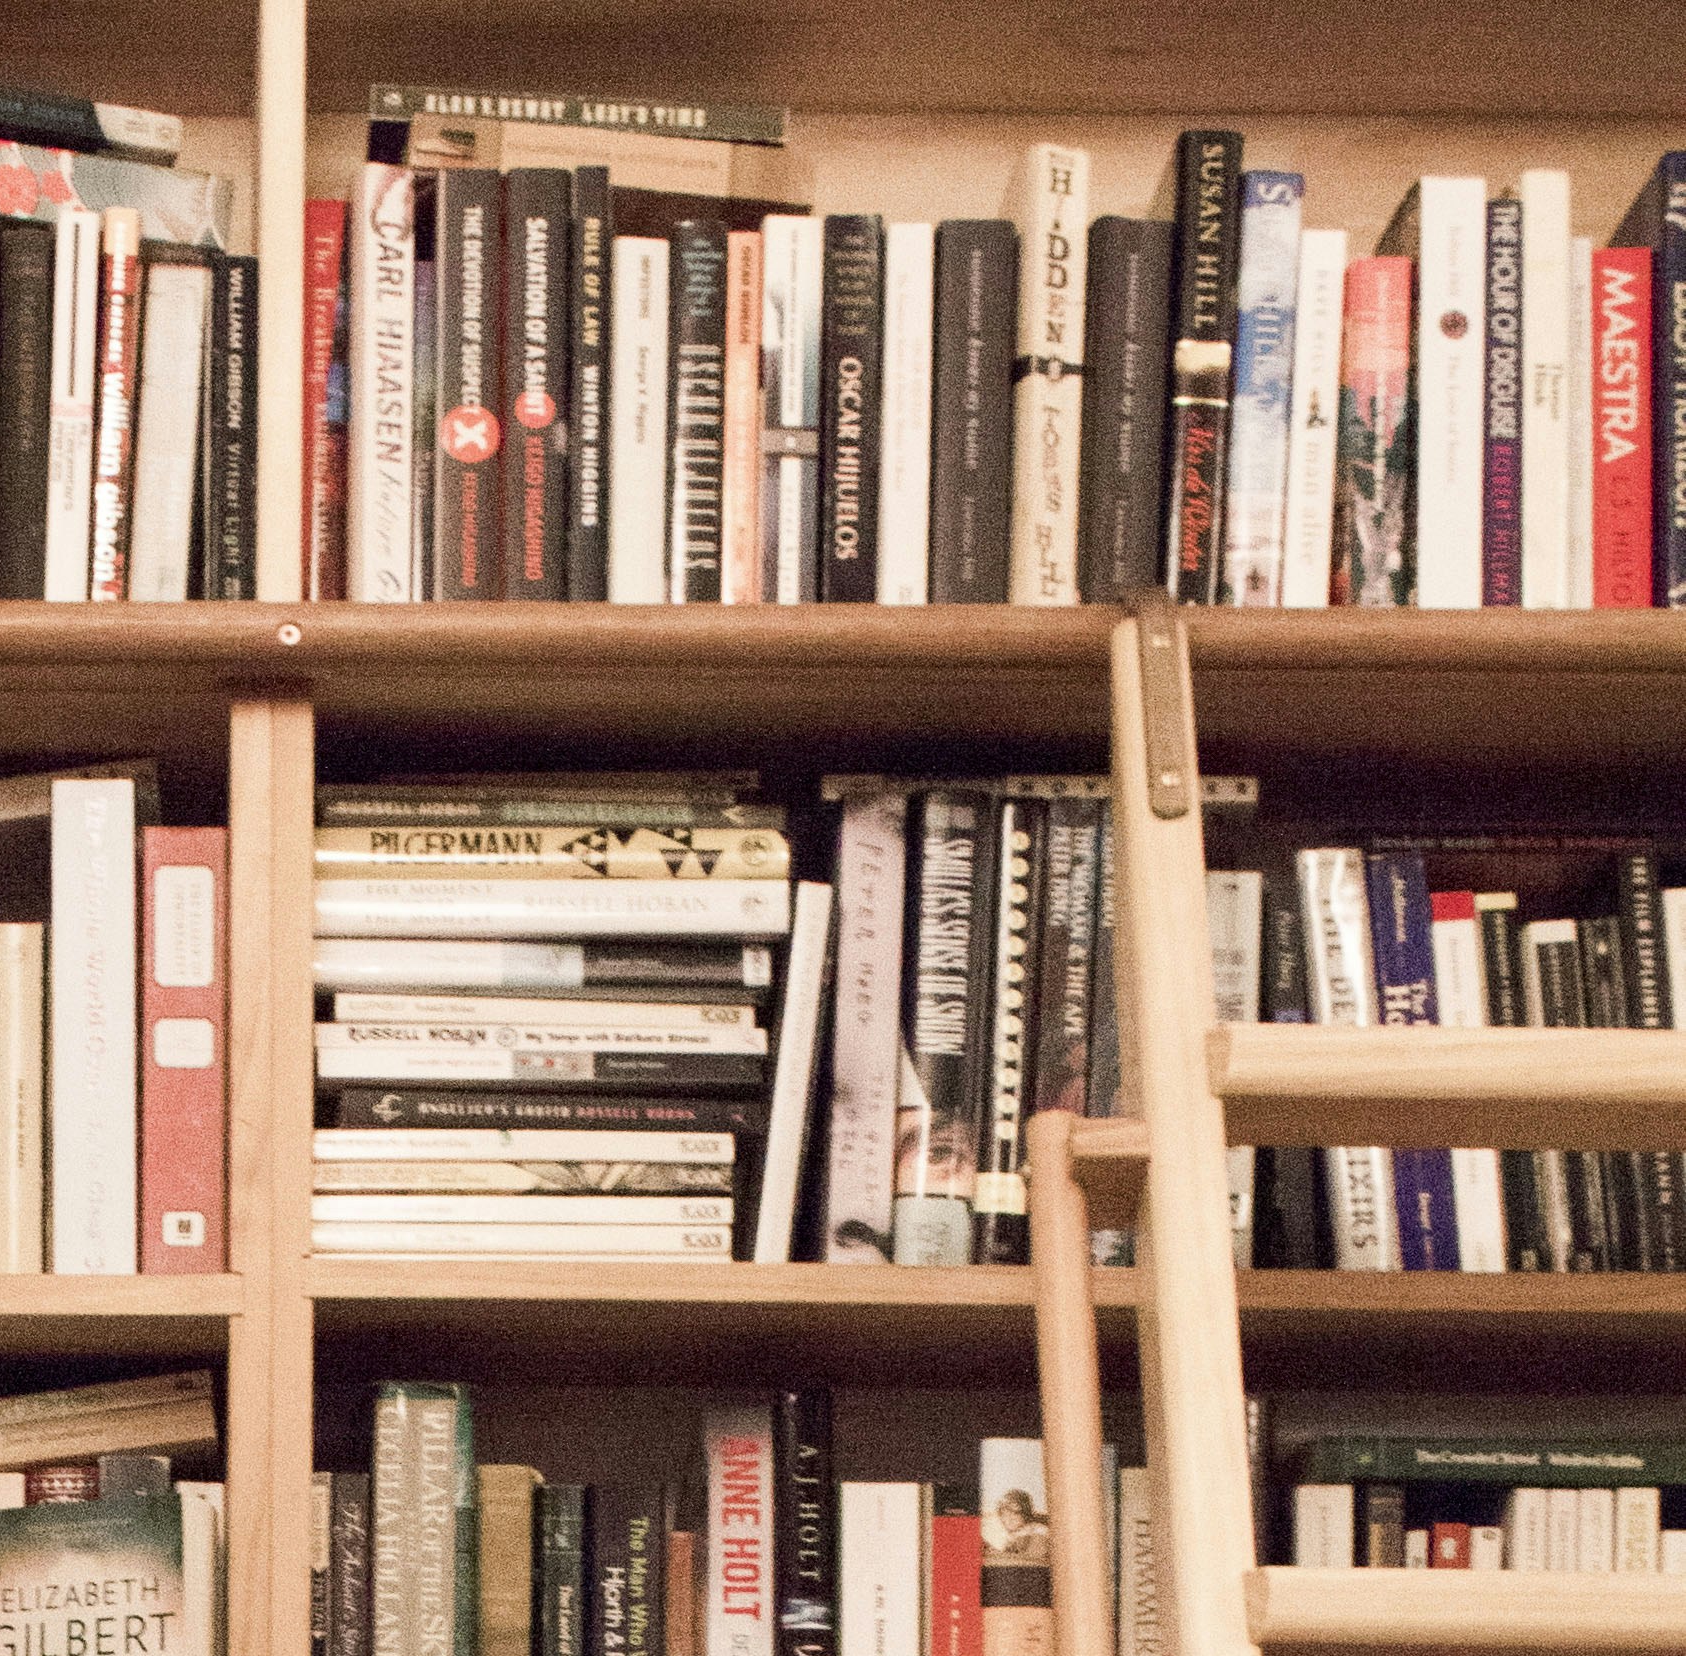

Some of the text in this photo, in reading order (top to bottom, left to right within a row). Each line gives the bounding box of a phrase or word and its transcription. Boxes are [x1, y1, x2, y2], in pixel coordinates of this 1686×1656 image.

[1194, 143, 1224, 329] SUSAN HILL
[376, 220, 406, 465] CARL HIAASEN
[454, 207, 487, 451] THE DEVOTION OF SUSPECT X
[524, 217, 547, 416] SALVATION OF A SAINT
[1601, 267, 1639, 463] MAESTRA
[834, 356, 863, 560] OSCAR HIJUELOS
[376, 1405, 402, 1525] CECELIA
[421, 1410, 450, 1526] PILLAR
[722, 1439, 760, 1526] ANNE
[1, 1577, 160, 1614] ELIZABETH
[420, 1527, 443, 1559] OF
[420, 1561, 443, 1613] THE
[722, 1538, 760, 1622] HOLT
